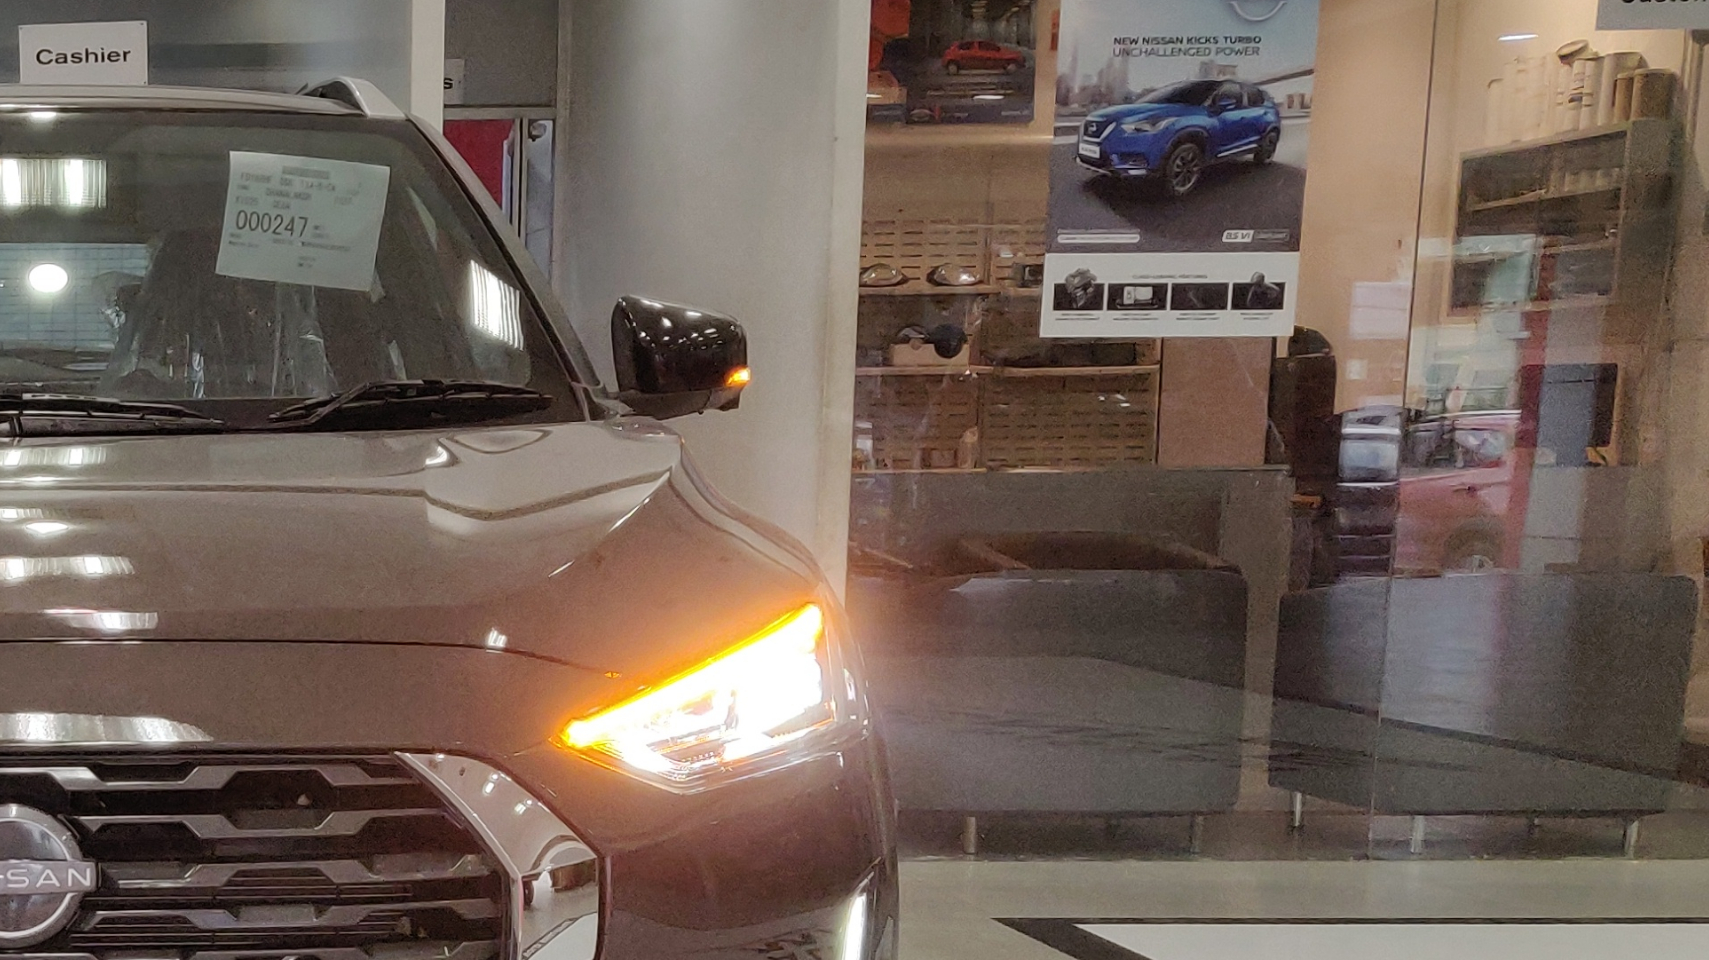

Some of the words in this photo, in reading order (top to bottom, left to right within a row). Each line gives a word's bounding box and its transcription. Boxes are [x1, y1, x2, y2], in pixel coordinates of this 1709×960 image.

[1113, 36, 1140, 46] NEW
[1142, 36, 1184, 45] NISSAN
[1186, 35, 1219, 45] KICKS
[1223, 35, 1262, 45] TURBO
[35, 47, 131, 65] Cashier
[1113, 47, 1212, 58] UNCHALLENGED
[1215, 46, 1261, 57] POWER
[235, 209, 309, 238] 000247
